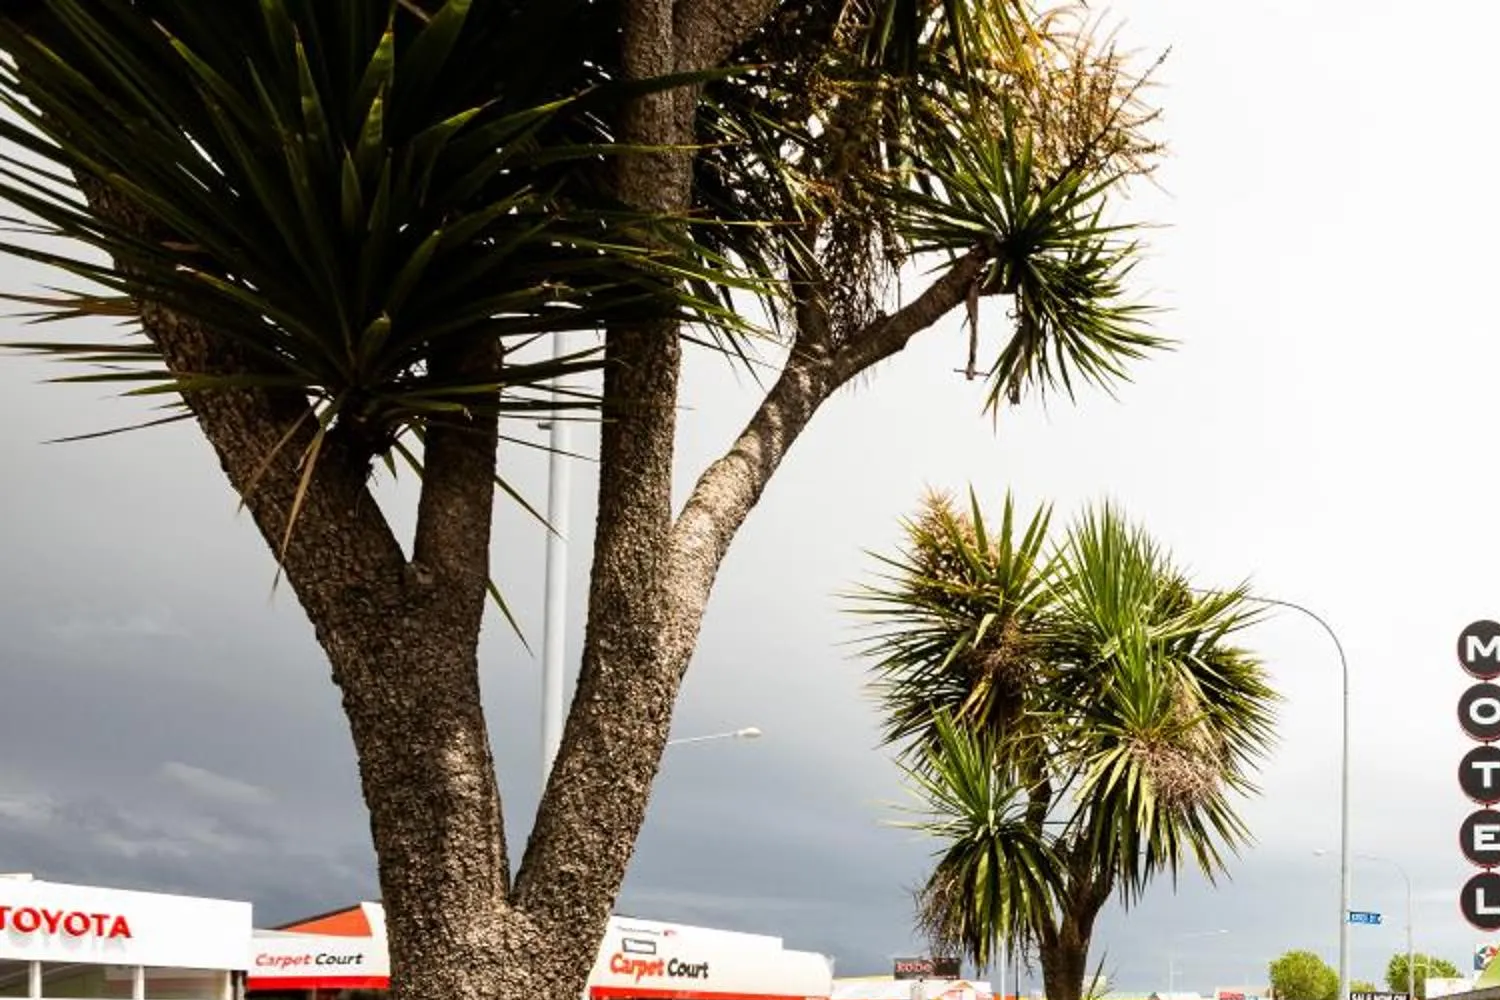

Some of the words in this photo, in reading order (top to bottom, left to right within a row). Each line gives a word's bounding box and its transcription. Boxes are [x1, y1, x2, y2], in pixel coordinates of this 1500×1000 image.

[0, 905, 132, 939] TOYOTA
[255, 953, 312, 968] Carpet
[315, 952, 363, 965] Court
[610, 953, 664, 983] Carpet
[668, 957, 709, 979] Court
